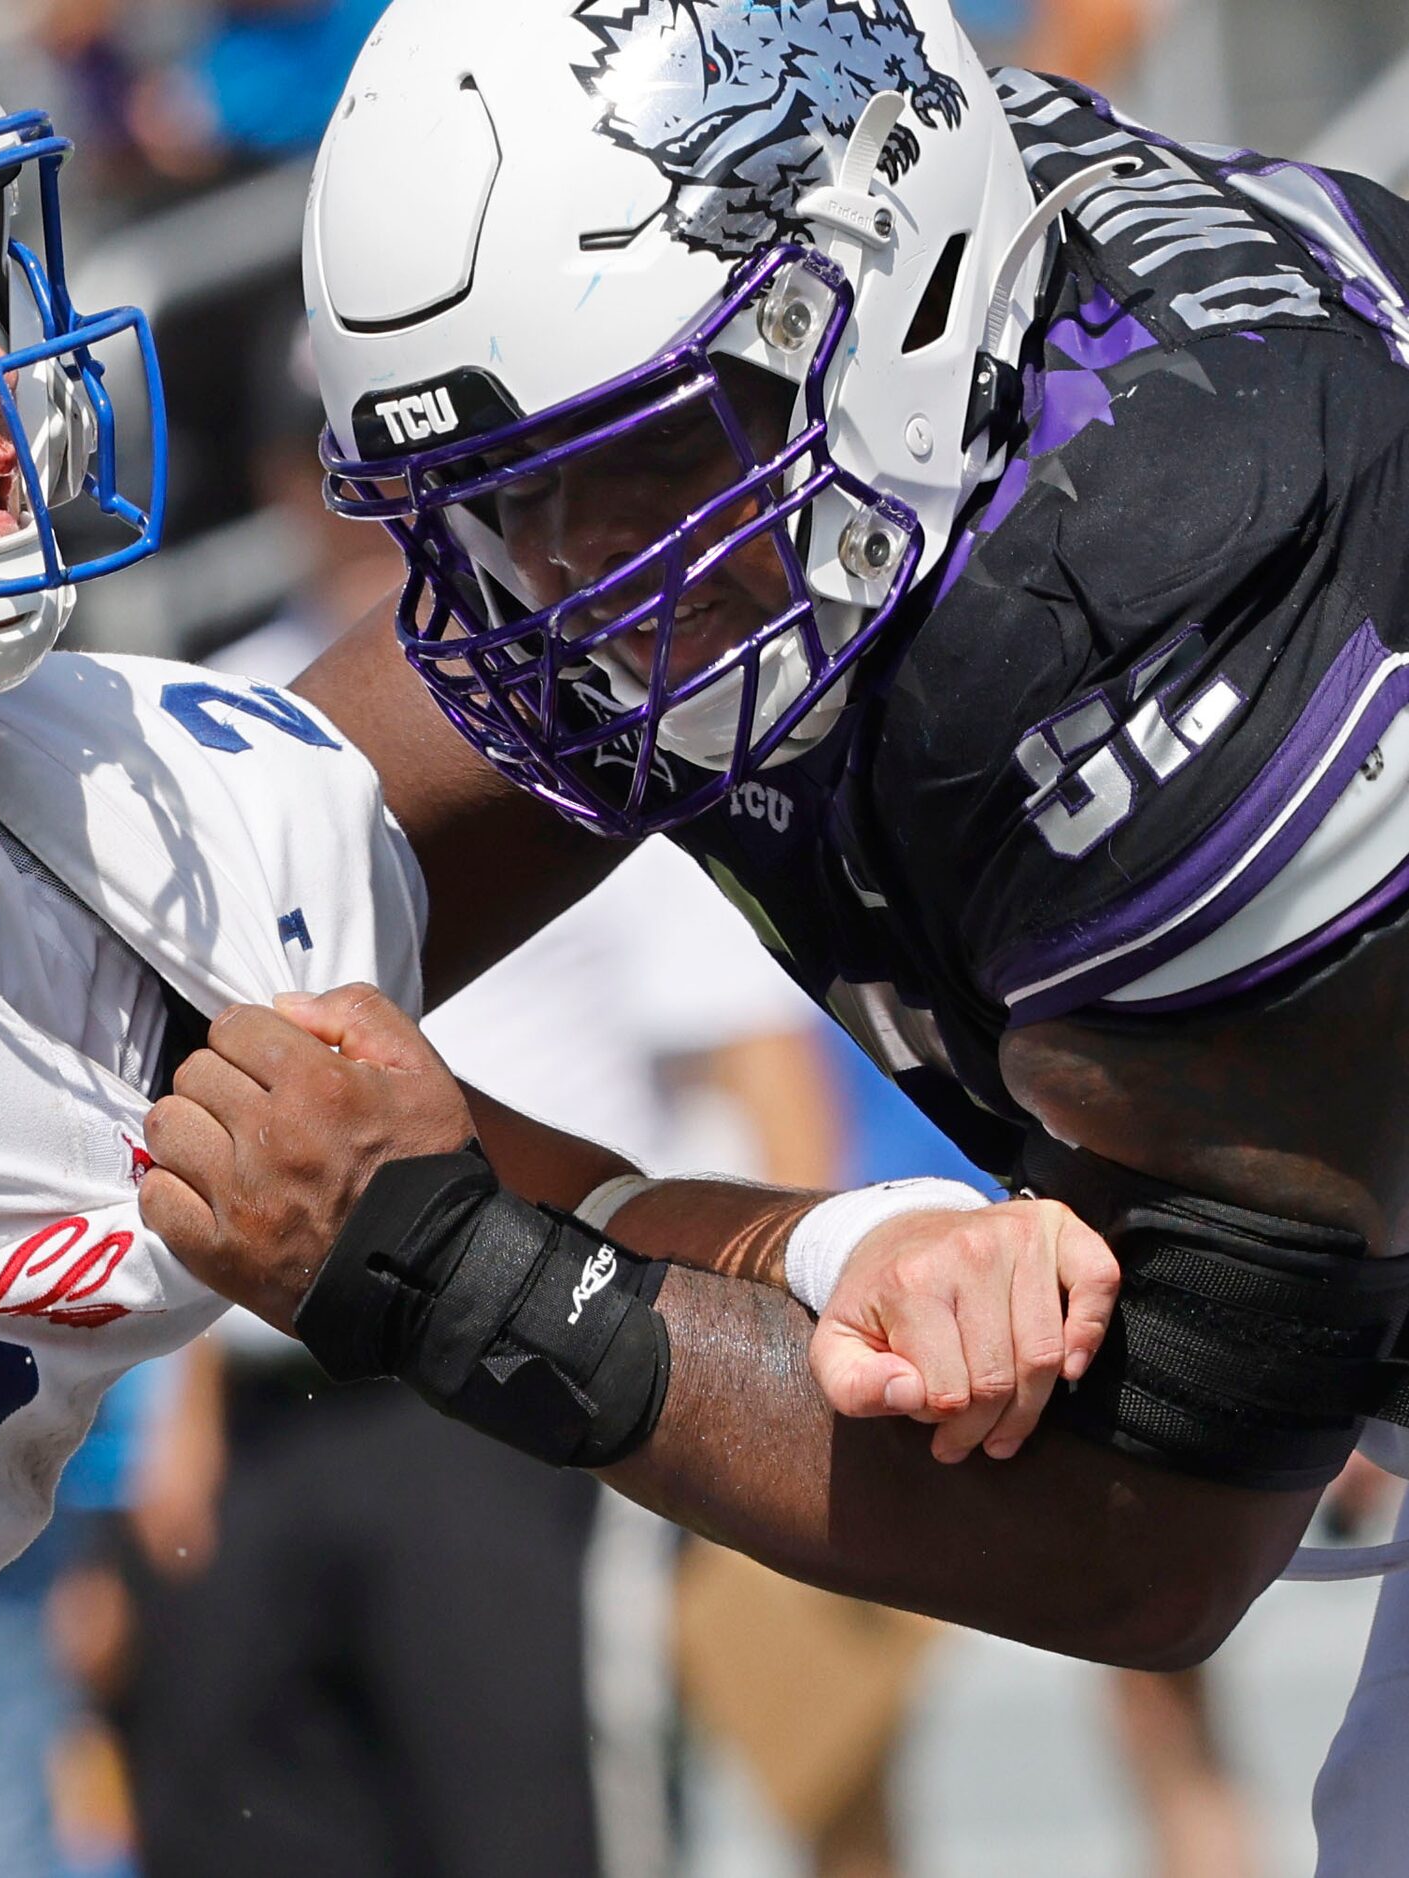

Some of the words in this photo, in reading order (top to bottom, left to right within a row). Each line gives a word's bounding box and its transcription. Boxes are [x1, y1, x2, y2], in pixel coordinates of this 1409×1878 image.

[829, 200, 873, 232] Riddell
[374, 386, 459, 445] TCU
[728, 780, 795, 834] TCU
